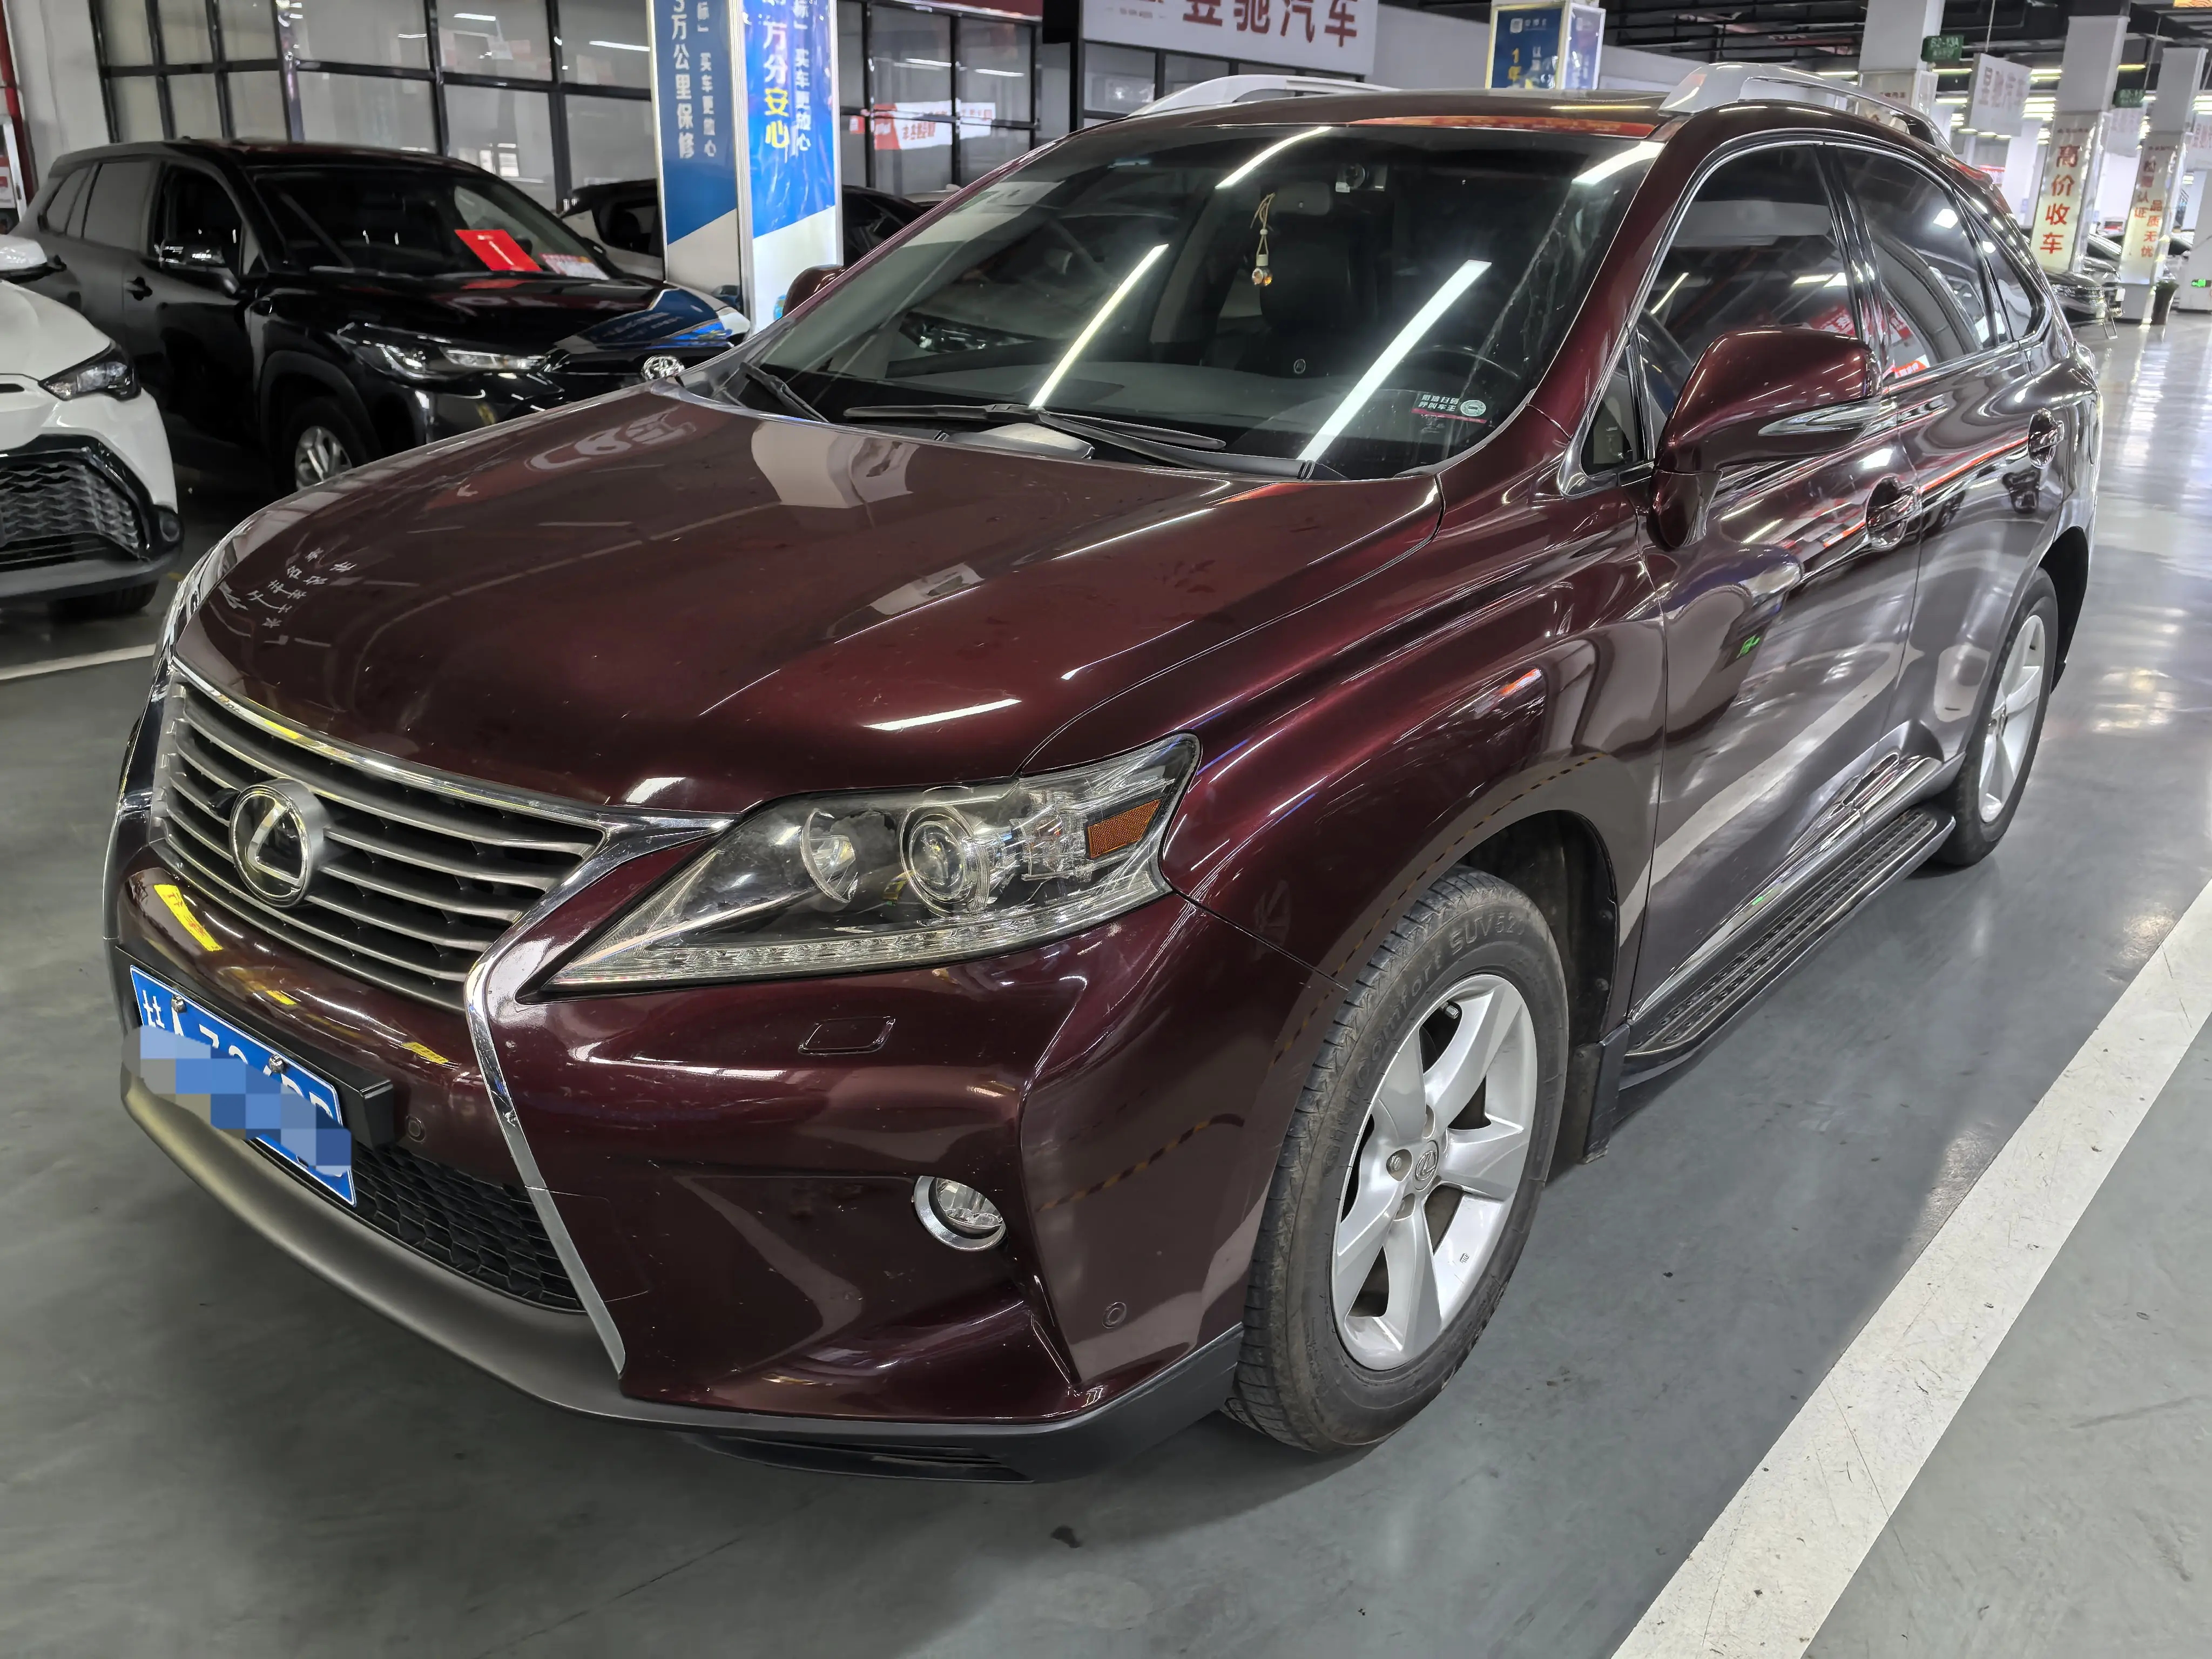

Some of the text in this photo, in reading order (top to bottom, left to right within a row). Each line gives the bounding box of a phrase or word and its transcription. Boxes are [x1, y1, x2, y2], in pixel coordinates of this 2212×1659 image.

[2040, 144, 2081, 254] 高价收车
[2140, 200, 2163, 258] 品质无忧
[1418, 401, 1457, 412] 呼叫车主
